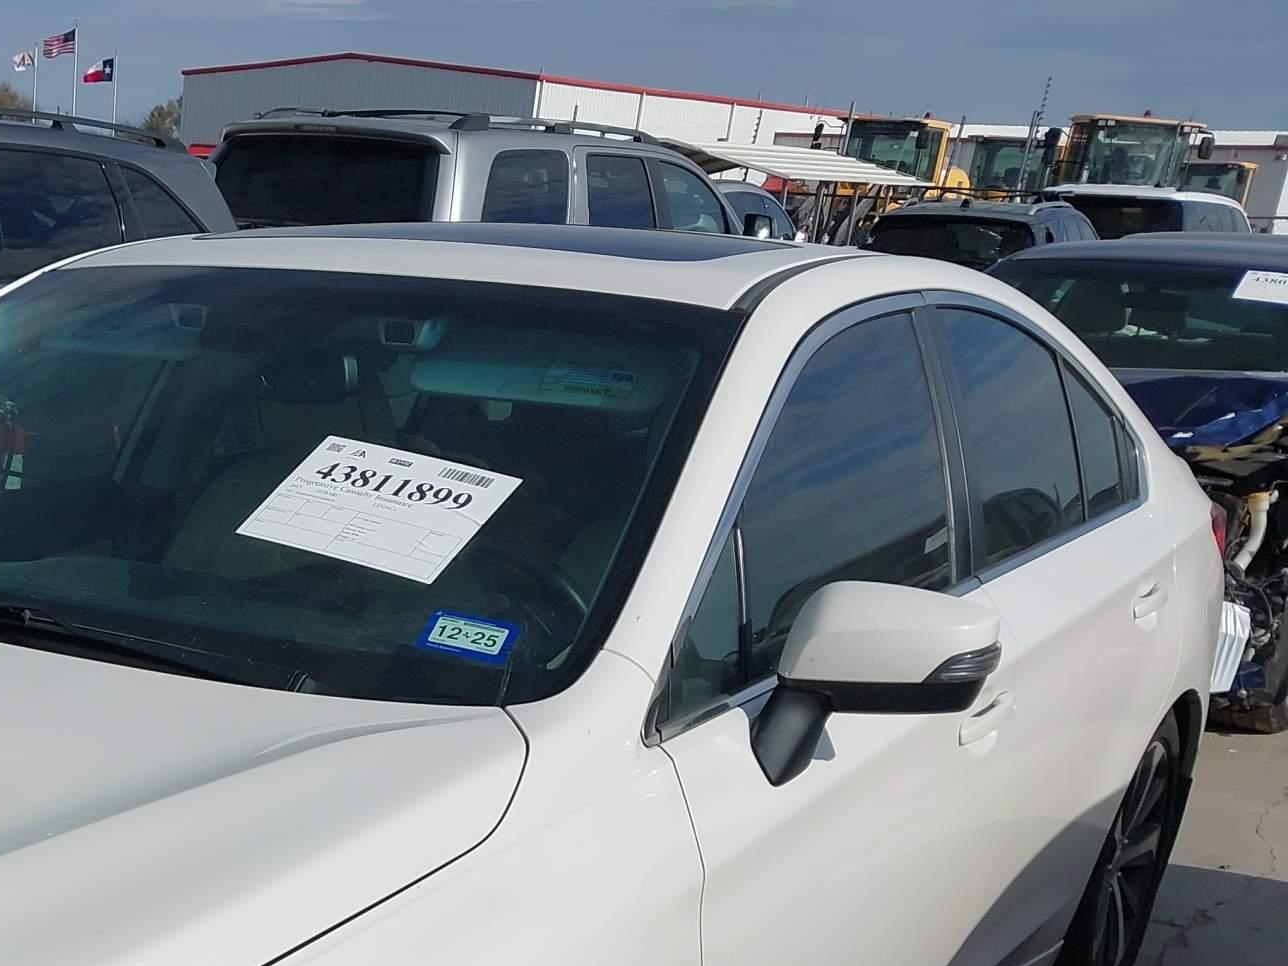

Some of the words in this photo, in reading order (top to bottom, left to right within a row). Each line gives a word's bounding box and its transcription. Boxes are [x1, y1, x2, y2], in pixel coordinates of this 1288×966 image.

[295, 475, 338, 492] Progressive
[339, 486, 374, 501] Casualty
[374, 494, 415, 509] Insurance
[315, 462, 473, 510] 43811899
[438, 625, 462, 641] 12
[470, 631, 499, 648] 25
